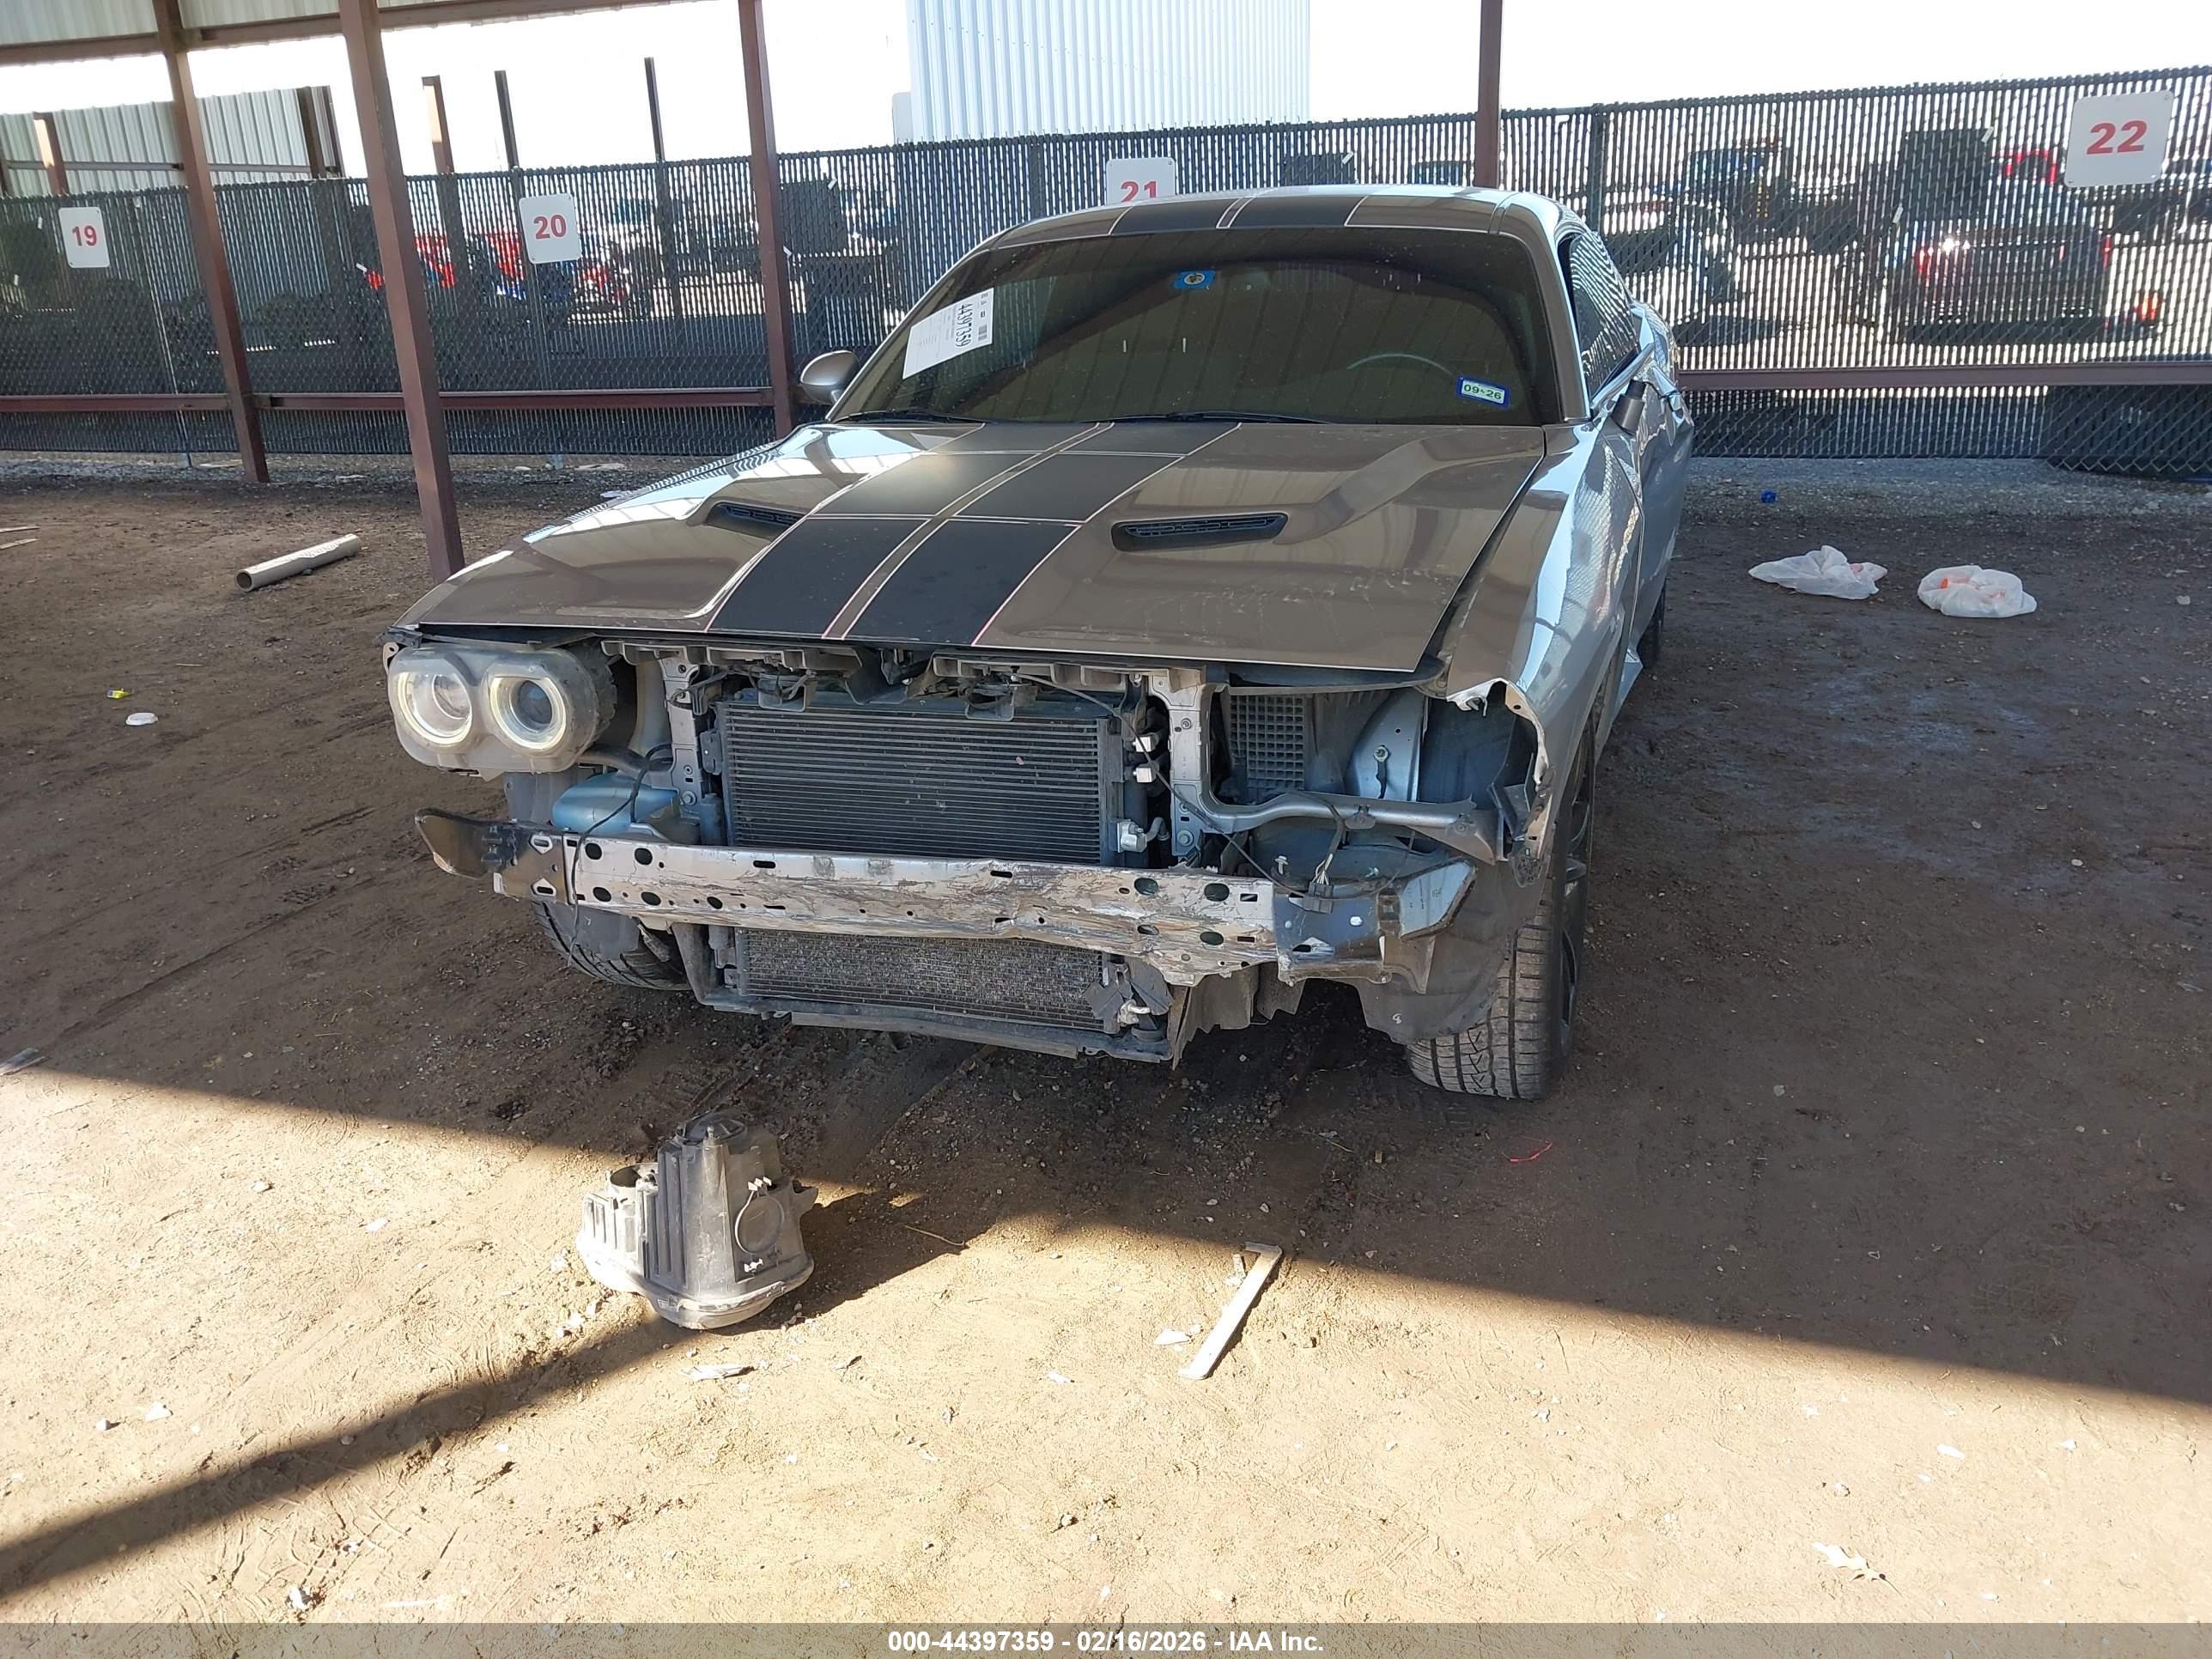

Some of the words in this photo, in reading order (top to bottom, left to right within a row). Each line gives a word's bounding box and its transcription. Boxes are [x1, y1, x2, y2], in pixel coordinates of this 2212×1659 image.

[2087, 121, 2148, 155] 22
[1121, 181, 1156, 203] 21
[72, 225, 97, 246] 19
[534, 214, 567, 239] 20
[955, 303, 974, 347] 44397359
